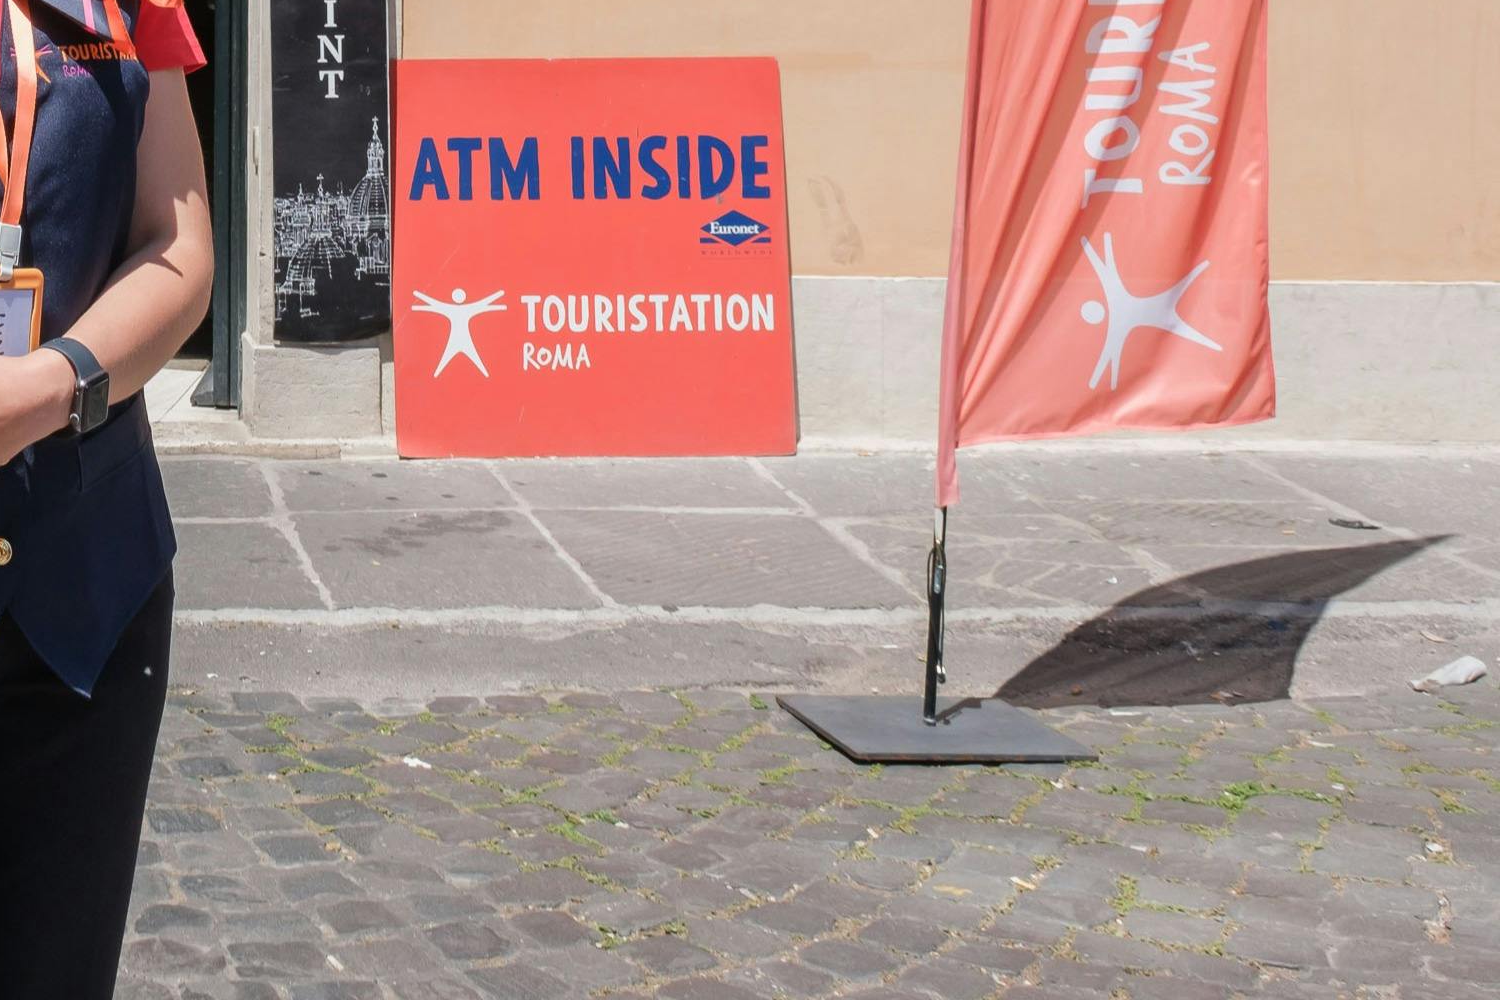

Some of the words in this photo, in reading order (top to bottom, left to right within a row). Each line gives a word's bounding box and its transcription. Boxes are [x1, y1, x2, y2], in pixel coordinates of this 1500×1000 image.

[62, 64, 91, 79] ROM
[409, 137, 540, 200] ATM
[571, 135, 771, 200] INSIDE
[710, 221, 760, 235] Euronet
[521, 294, 775, 333] TOURISTATION
